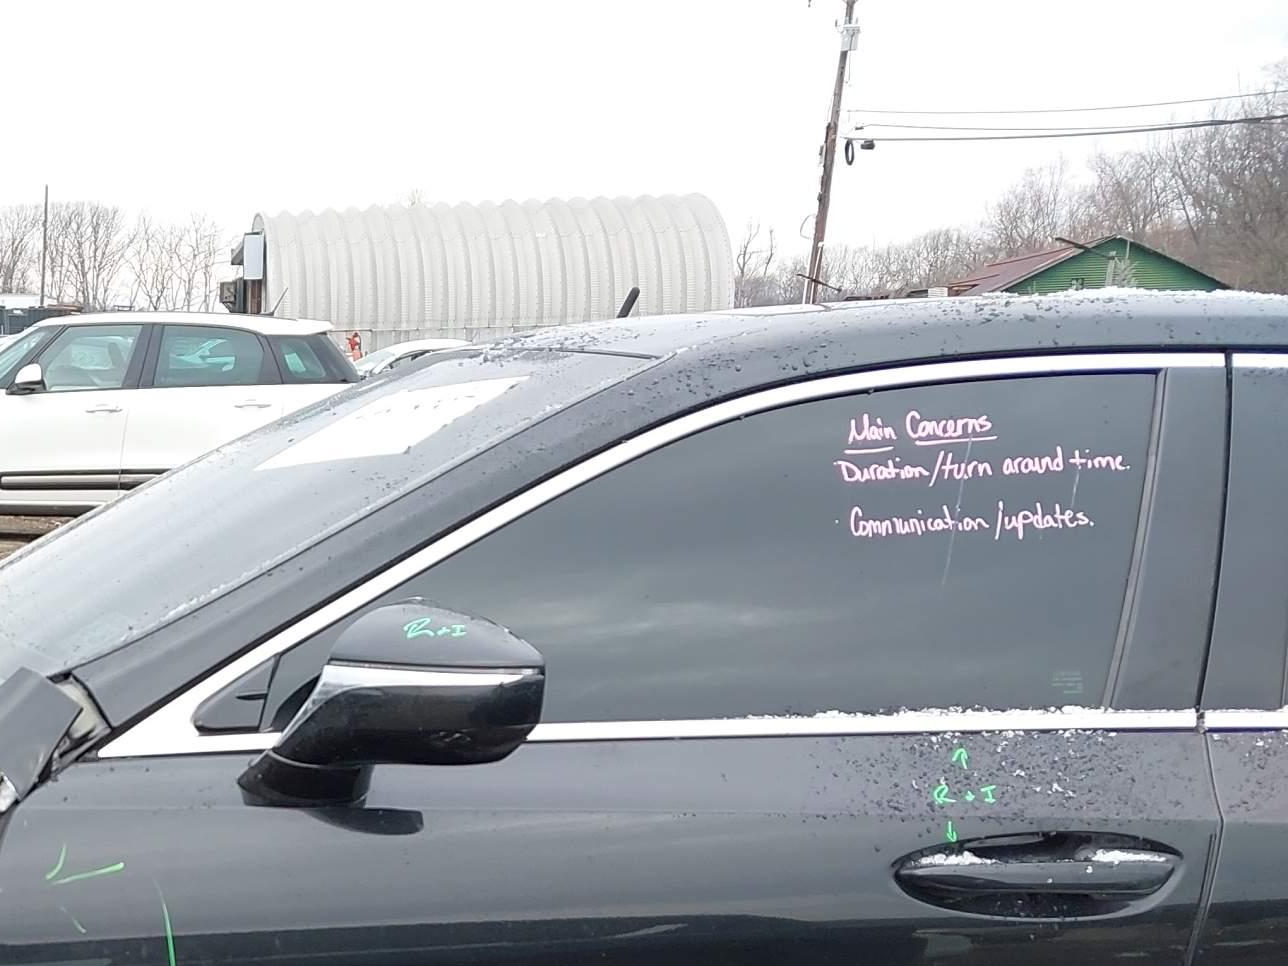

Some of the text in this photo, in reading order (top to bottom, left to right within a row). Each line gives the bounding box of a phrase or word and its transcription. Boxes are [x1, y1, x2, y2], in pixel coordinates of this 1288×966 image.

[847, 410, 993, 445] Main Concerns
[1002, 445, 1064, 475] around
